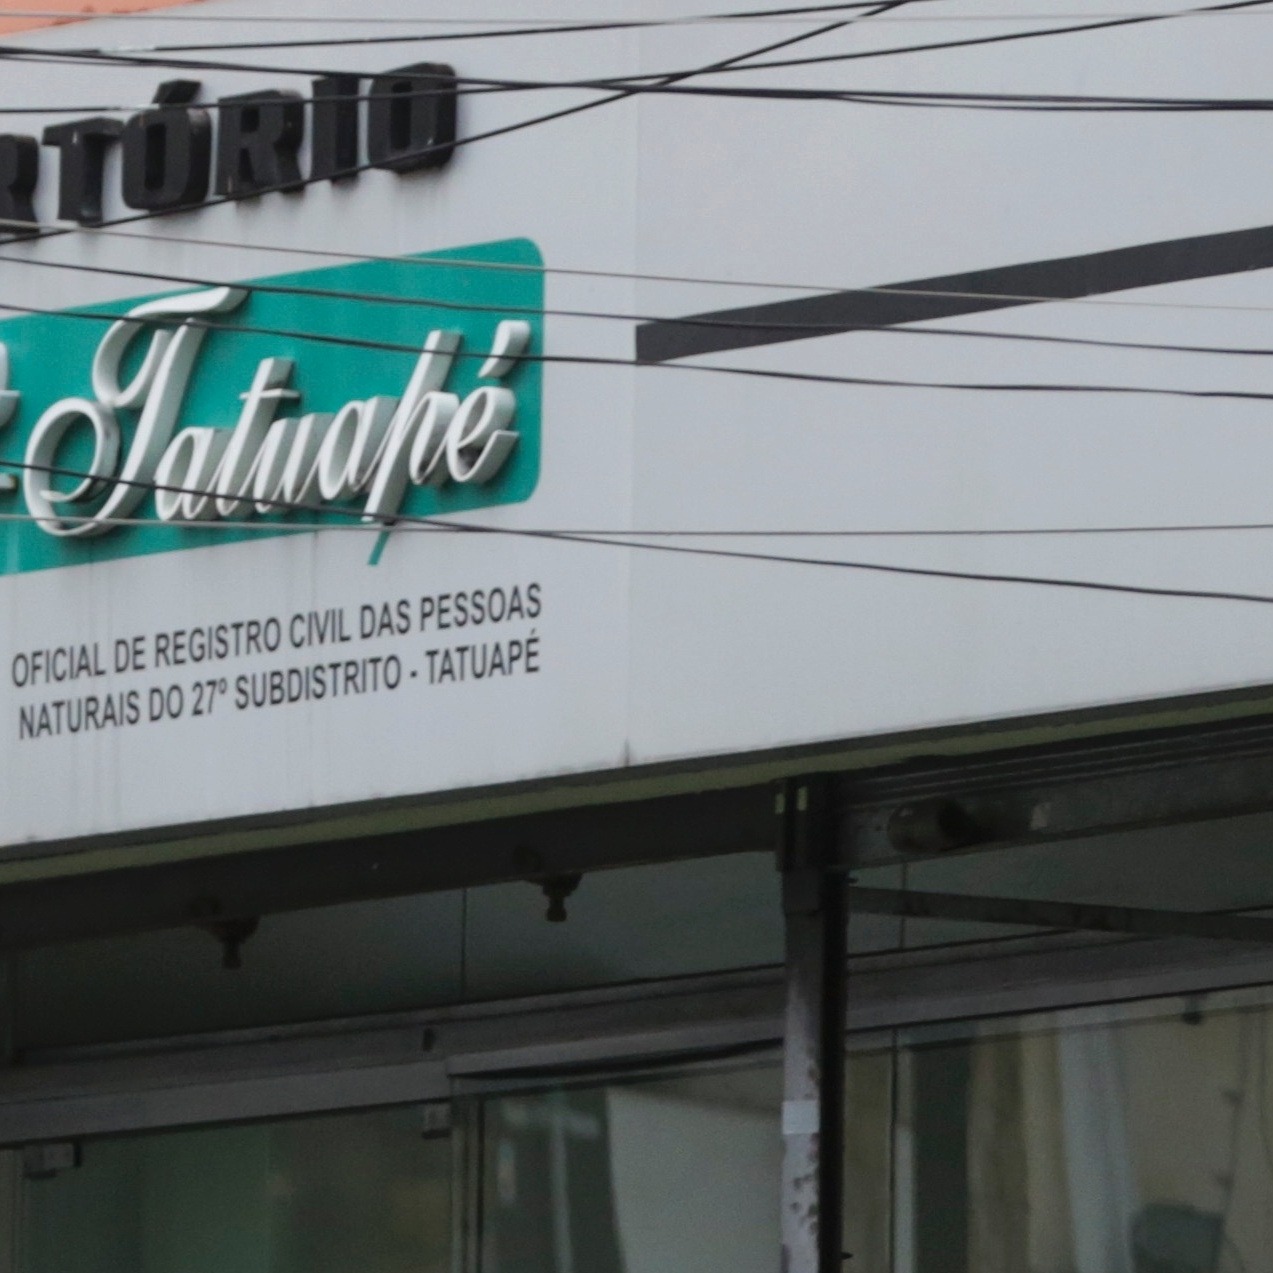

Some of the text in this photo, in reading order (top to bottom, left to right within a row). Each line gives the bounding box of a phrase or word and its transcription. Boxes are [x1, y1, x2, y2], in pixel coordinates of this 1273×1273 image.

[24, 286, 531, 537] Tatuapé
[12, 582, 541, 688] OFICIAL DE REGISTRO CIVIL DAS PESSOAS
[19, 691, 140, 740] NATURAIS
[150, 685, 184, 722] DO
[192, 679, 228, 717] 27º
[235, 654, 402, 711] SUBDISTRITO
[426, 629, 540, 686] TATUAPÉ
